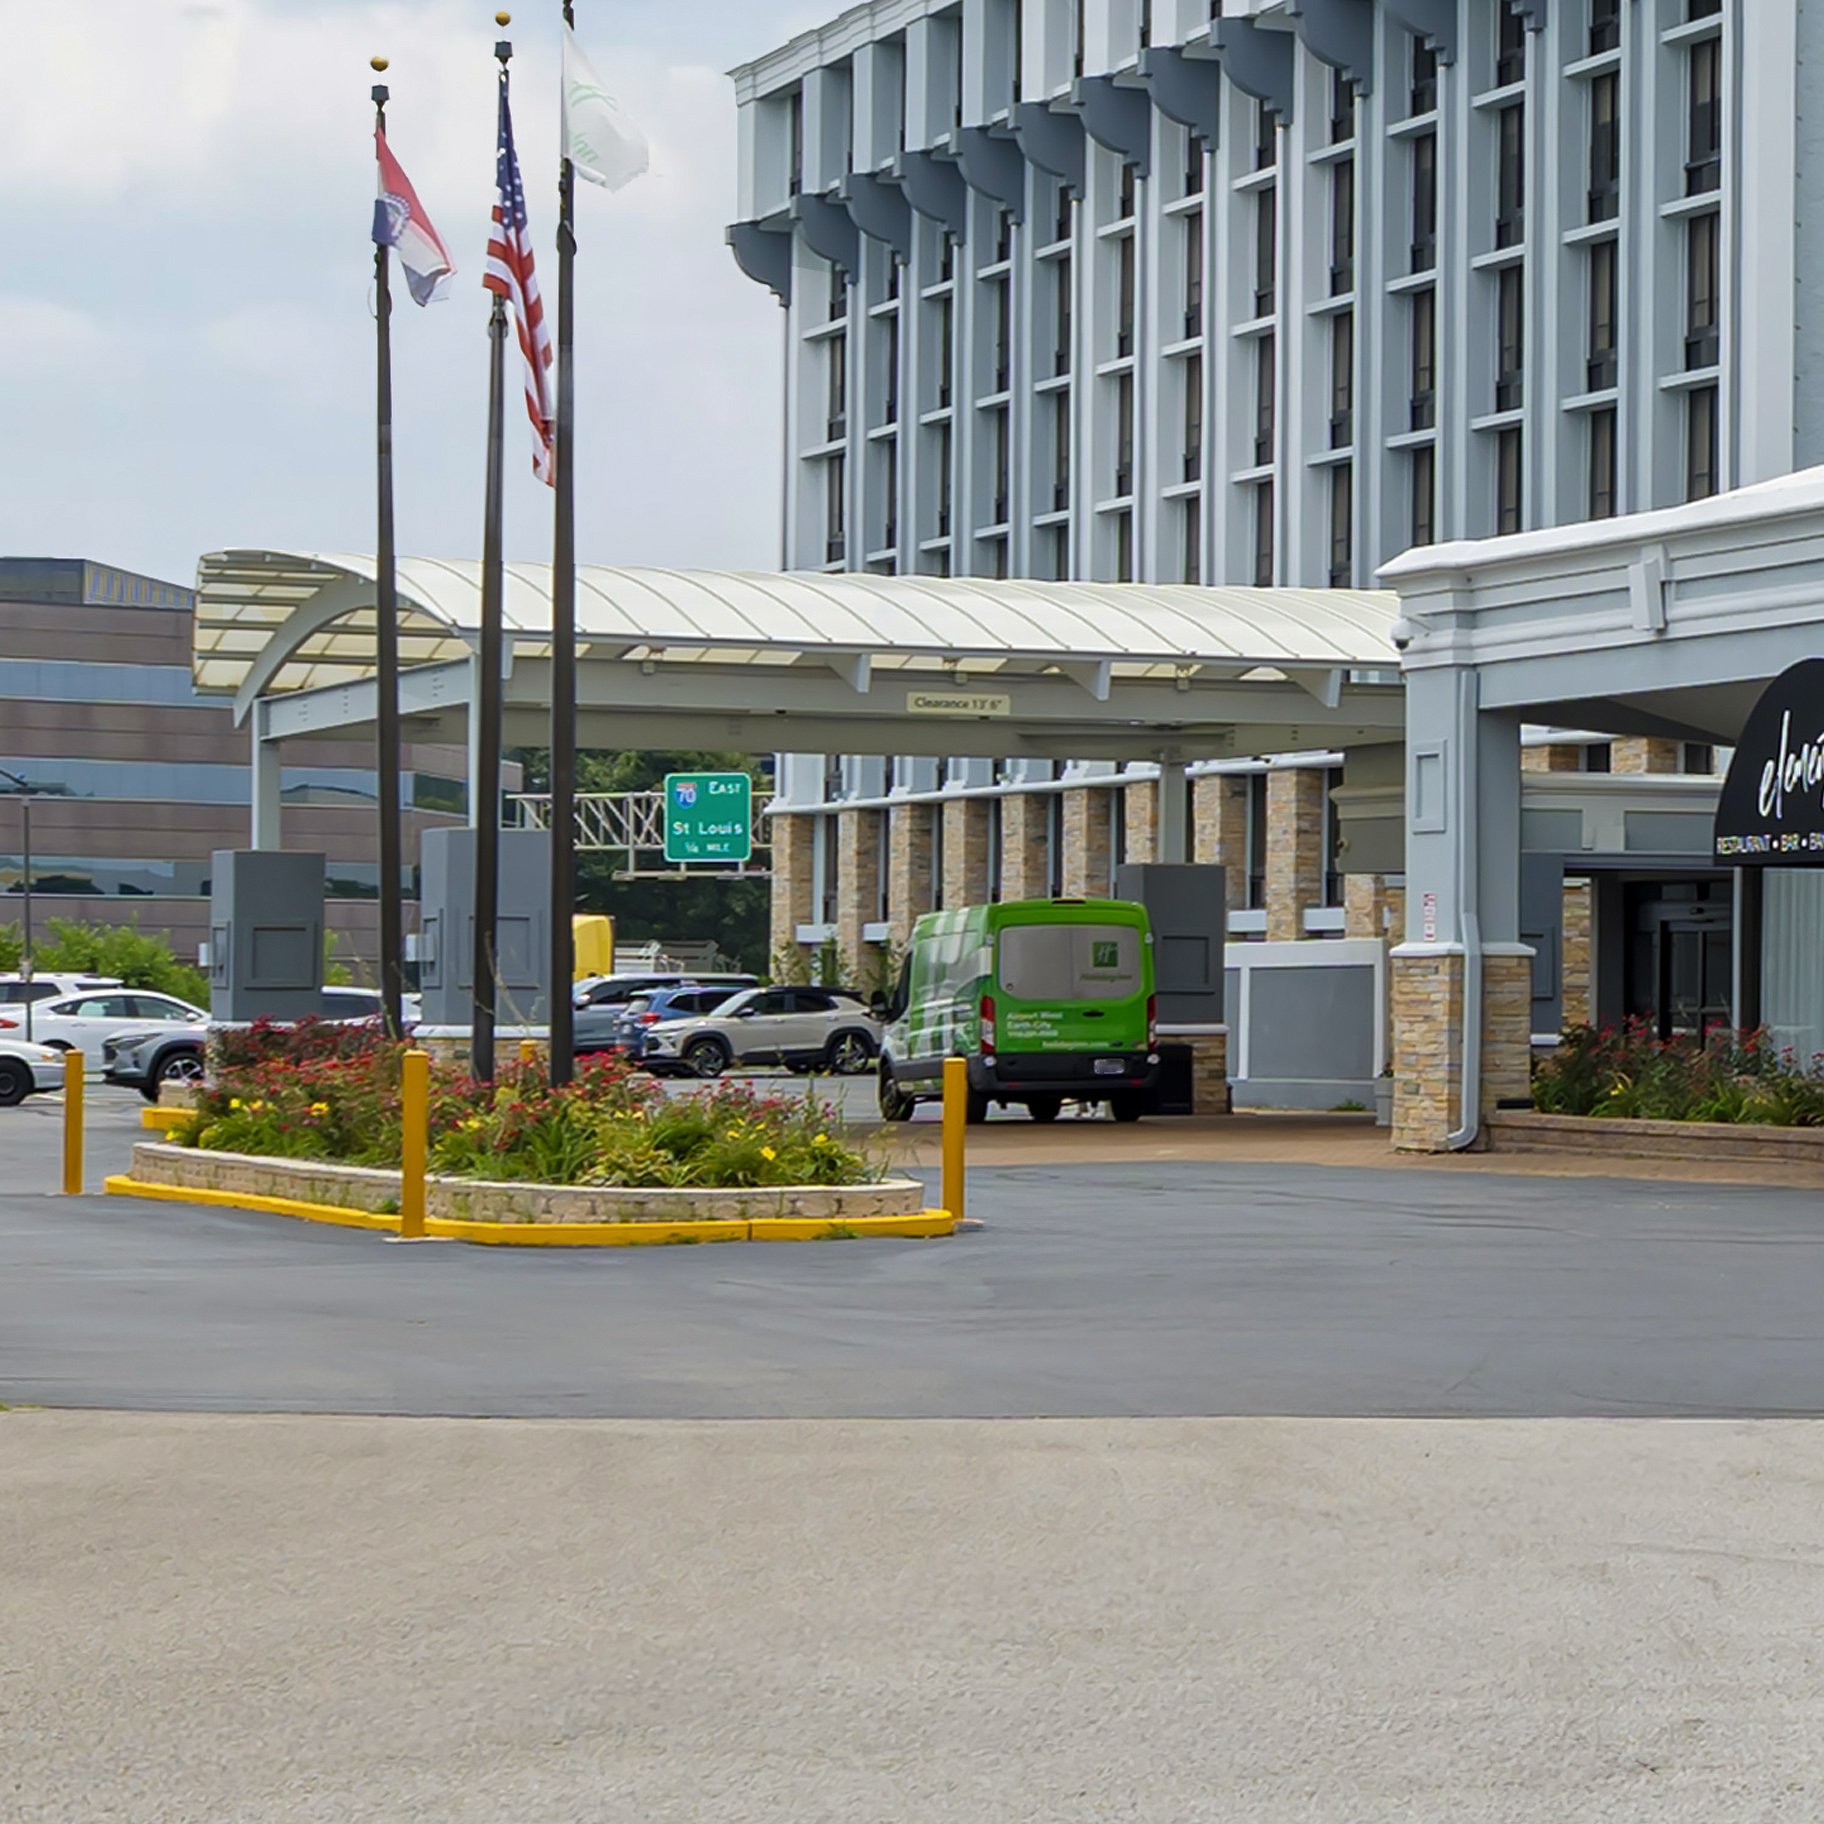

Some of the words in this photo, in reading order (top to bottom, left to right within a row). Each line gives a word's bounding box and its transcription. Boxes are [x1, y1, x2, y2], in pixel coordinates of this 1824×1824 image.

[914, 696, 969, 709] Clearance
[676, 788, 698, 803] 70
[673, 821, 691, 835] St
[698, 821, 743, 835] Louis
[706, 842, 731, 853] MILE
[1716, 834, 1771, 855] RESTAURANT
[1780, 833, 1800, 853] BAR
